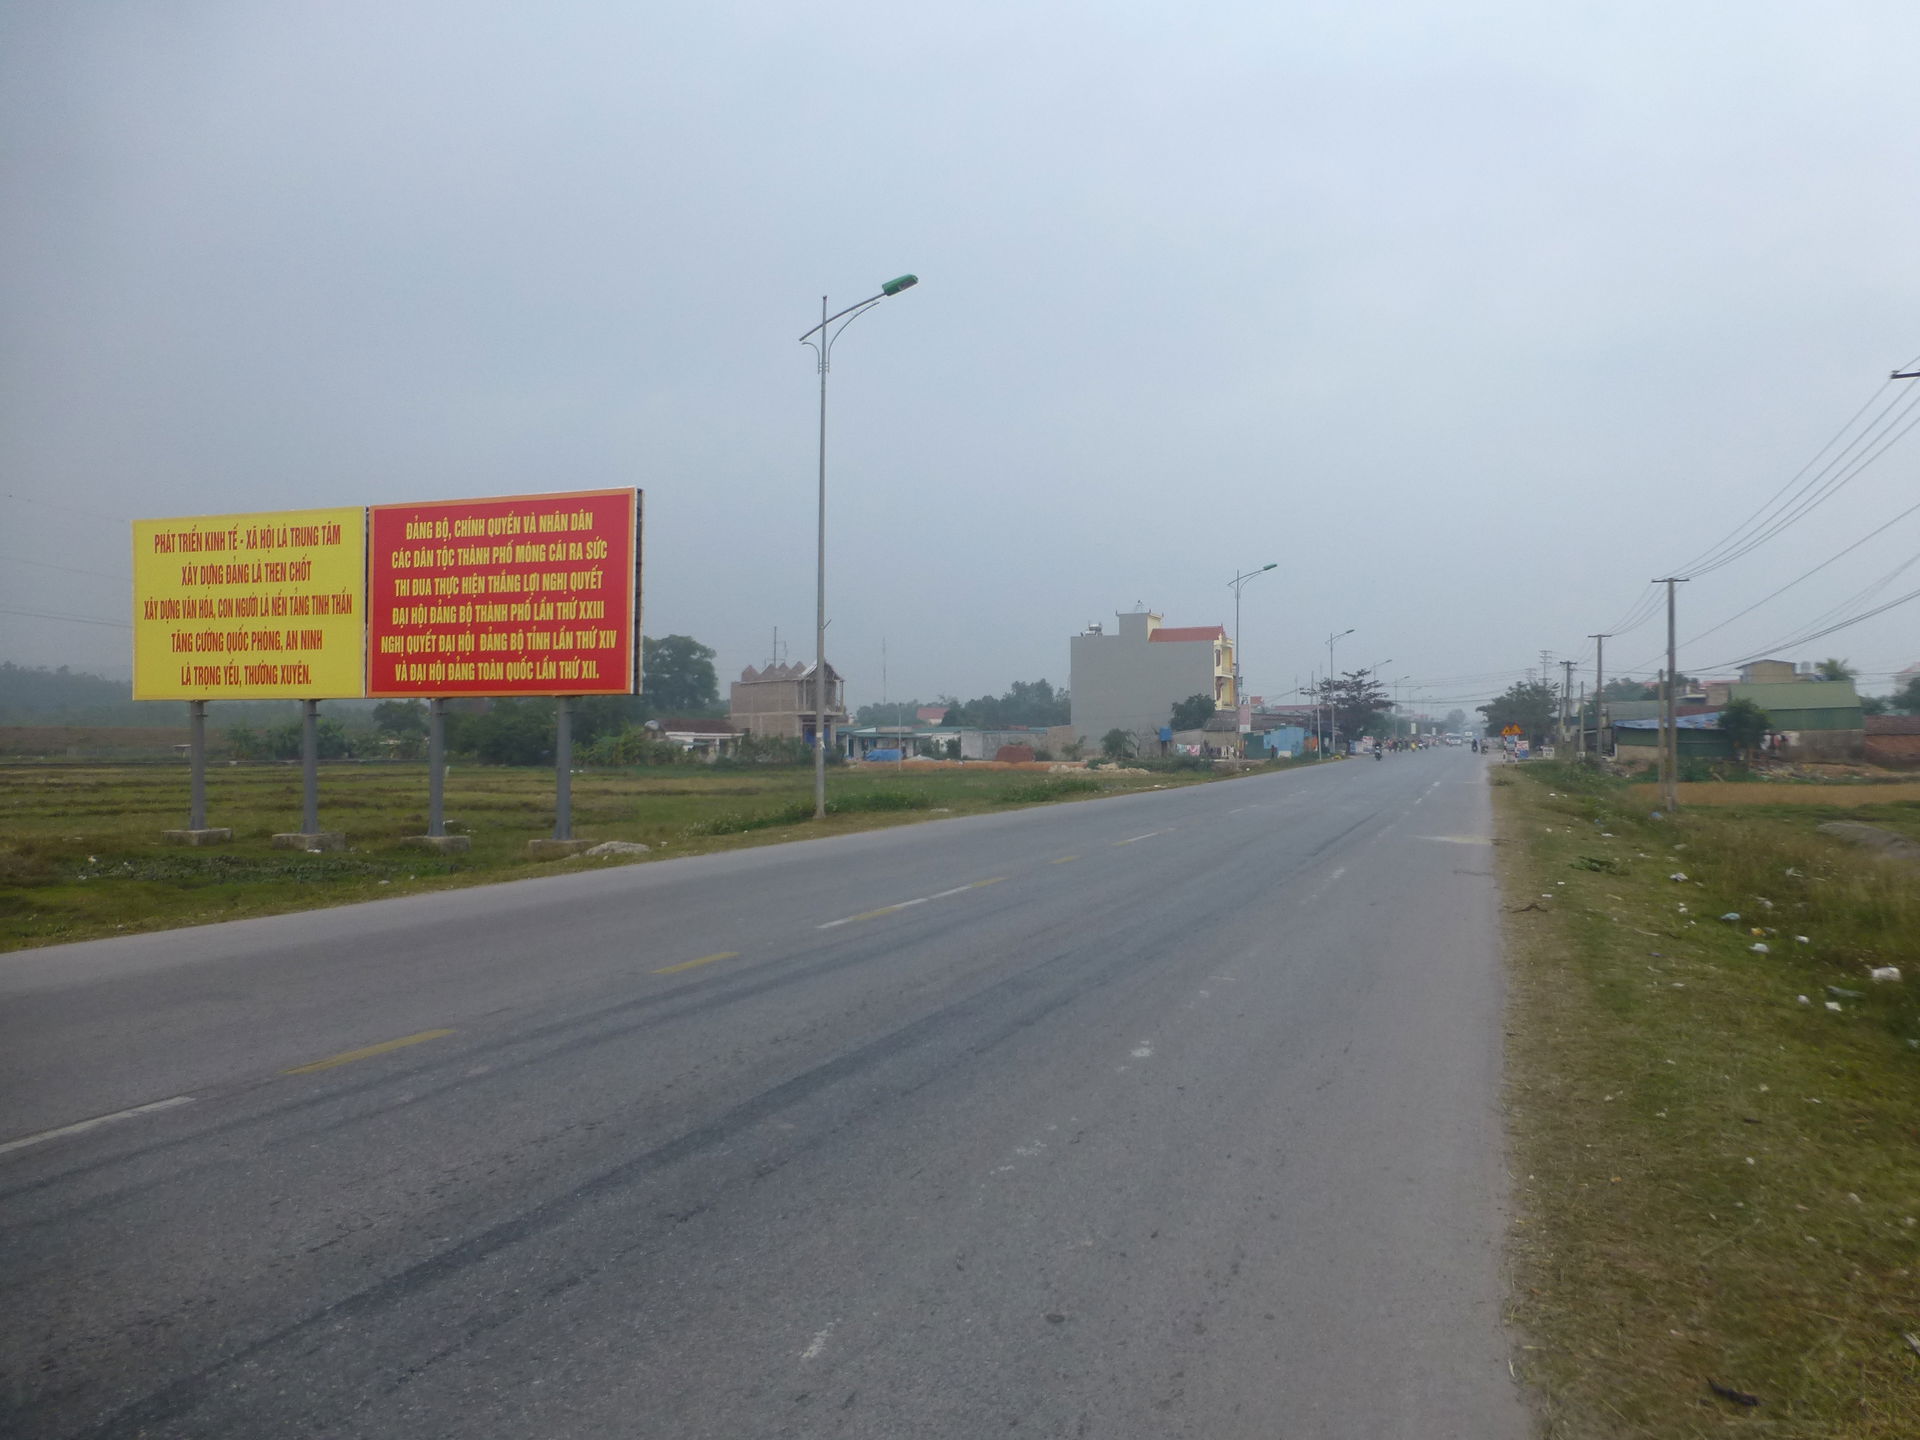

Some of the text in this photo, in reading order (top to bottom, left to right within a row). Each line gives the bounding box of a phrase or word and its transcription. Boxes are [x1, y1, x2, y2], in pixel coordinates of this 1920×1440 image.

[155, 529, 175, 553] PHÁT
[178, 524, 202, 552] TRIỂN
[205, 531, 225, 551] KINH
[228, 523, 238, 550] TẾ
[260, 525, 274, 553] HỘI
[277, 524, 287, 548] LÀ
[290, 526, 319, 547] TRUNG
[322, 521, 340, 545] TÂM
[406, 515, 432, 540] ĐẢNG
[436, 517, 451, 542] BỘ,
[455, 516, 484, 537] CHÍNH
[524, 512, 536, 533] VÀ
[539, 511, 568, 532] NHÂN
[571, 509, 593, 531] DÂN
[392, 547, 411, 568] CÁC
[414, 547, 433, 568] DÂN
[437, 545, 454, 570] TỘC
[458, 544, 490, 565] THÀNH
[492, 540, 513, 564] PHỐ
[549, 540, 566, 561] CÁI
[569, 542, 583, 560] RA
[586, 536, 607, 559] SỨC
[182, 554, 311, 589] XÂY DỰNG ĐẢNG LÀ THEN CHỐT
[395, 565, 603, 598] THI ĐUA THỰC HIỆN THẮNG LỢI NGHỊ QUYẾT
[144, 597, 158, 620] XÂY
[161, 598, 180, 623] DỰNG
[199, 595, 215, 619] HÓA,
[218, 599, 233, 618] CON
[235, 592, 258, 618] NGƯỜI
[261, 593, 269, 616] LÀ
[290, 587, 309, 615] TẢNG
[312, 595, 329, 615] TINH
[392, 607, 408, 628] ĐẠI
[411, 603, 427, 628] HỘI
[430, 599, 456, 623] ĐẢNG
[459, 602, 472, 627] BỘ
[475, 600, 507, 622] THÀNH
[511, 597, 532, 621] PHỐ
[557, 597, 577, 620] THỨ
[579, 601, 604, 619] XXIII
[196, 628, 223, 652] CƯỜNG
[227, 625, 248, 654] QUỐC
[252, 626, 283, 653] PHÒNG,
[286, 631, 297, 650] AN
[301, 630, 322, 649] NINH
[381, 635, 404, 656] NGHỊ
[407, 629, 437, 655] QUYẾT
[439, 634, 455, 656] ĐẠI
[458, 631, 475, 655] HỘI
[480, 625, 507, 651] ĐẢNG
[511, 629, 524, 654] BỘ
[527, 626, 550, 650] TỈNH
[576, 626, 597, 649] THỨ
[599, 630, 617, 649] XIV
[181, 659, 311, 690] LÀ TRỌNG YẾU, THƯỜNG XUYÊN.
[395, 660, 407, 681] VÀ
[410, 663, 426, 685] ĐẠI
[429, 660, 445, 685] HỘI
[448, 656, 475, 680] ĐẢNG
[477, 659, 504, 681] TOÀN
[507, 656, 533, 682] QUỐC
[560, 656, 580, 679] THỨ
[582, 661, 599, 679] XII.
